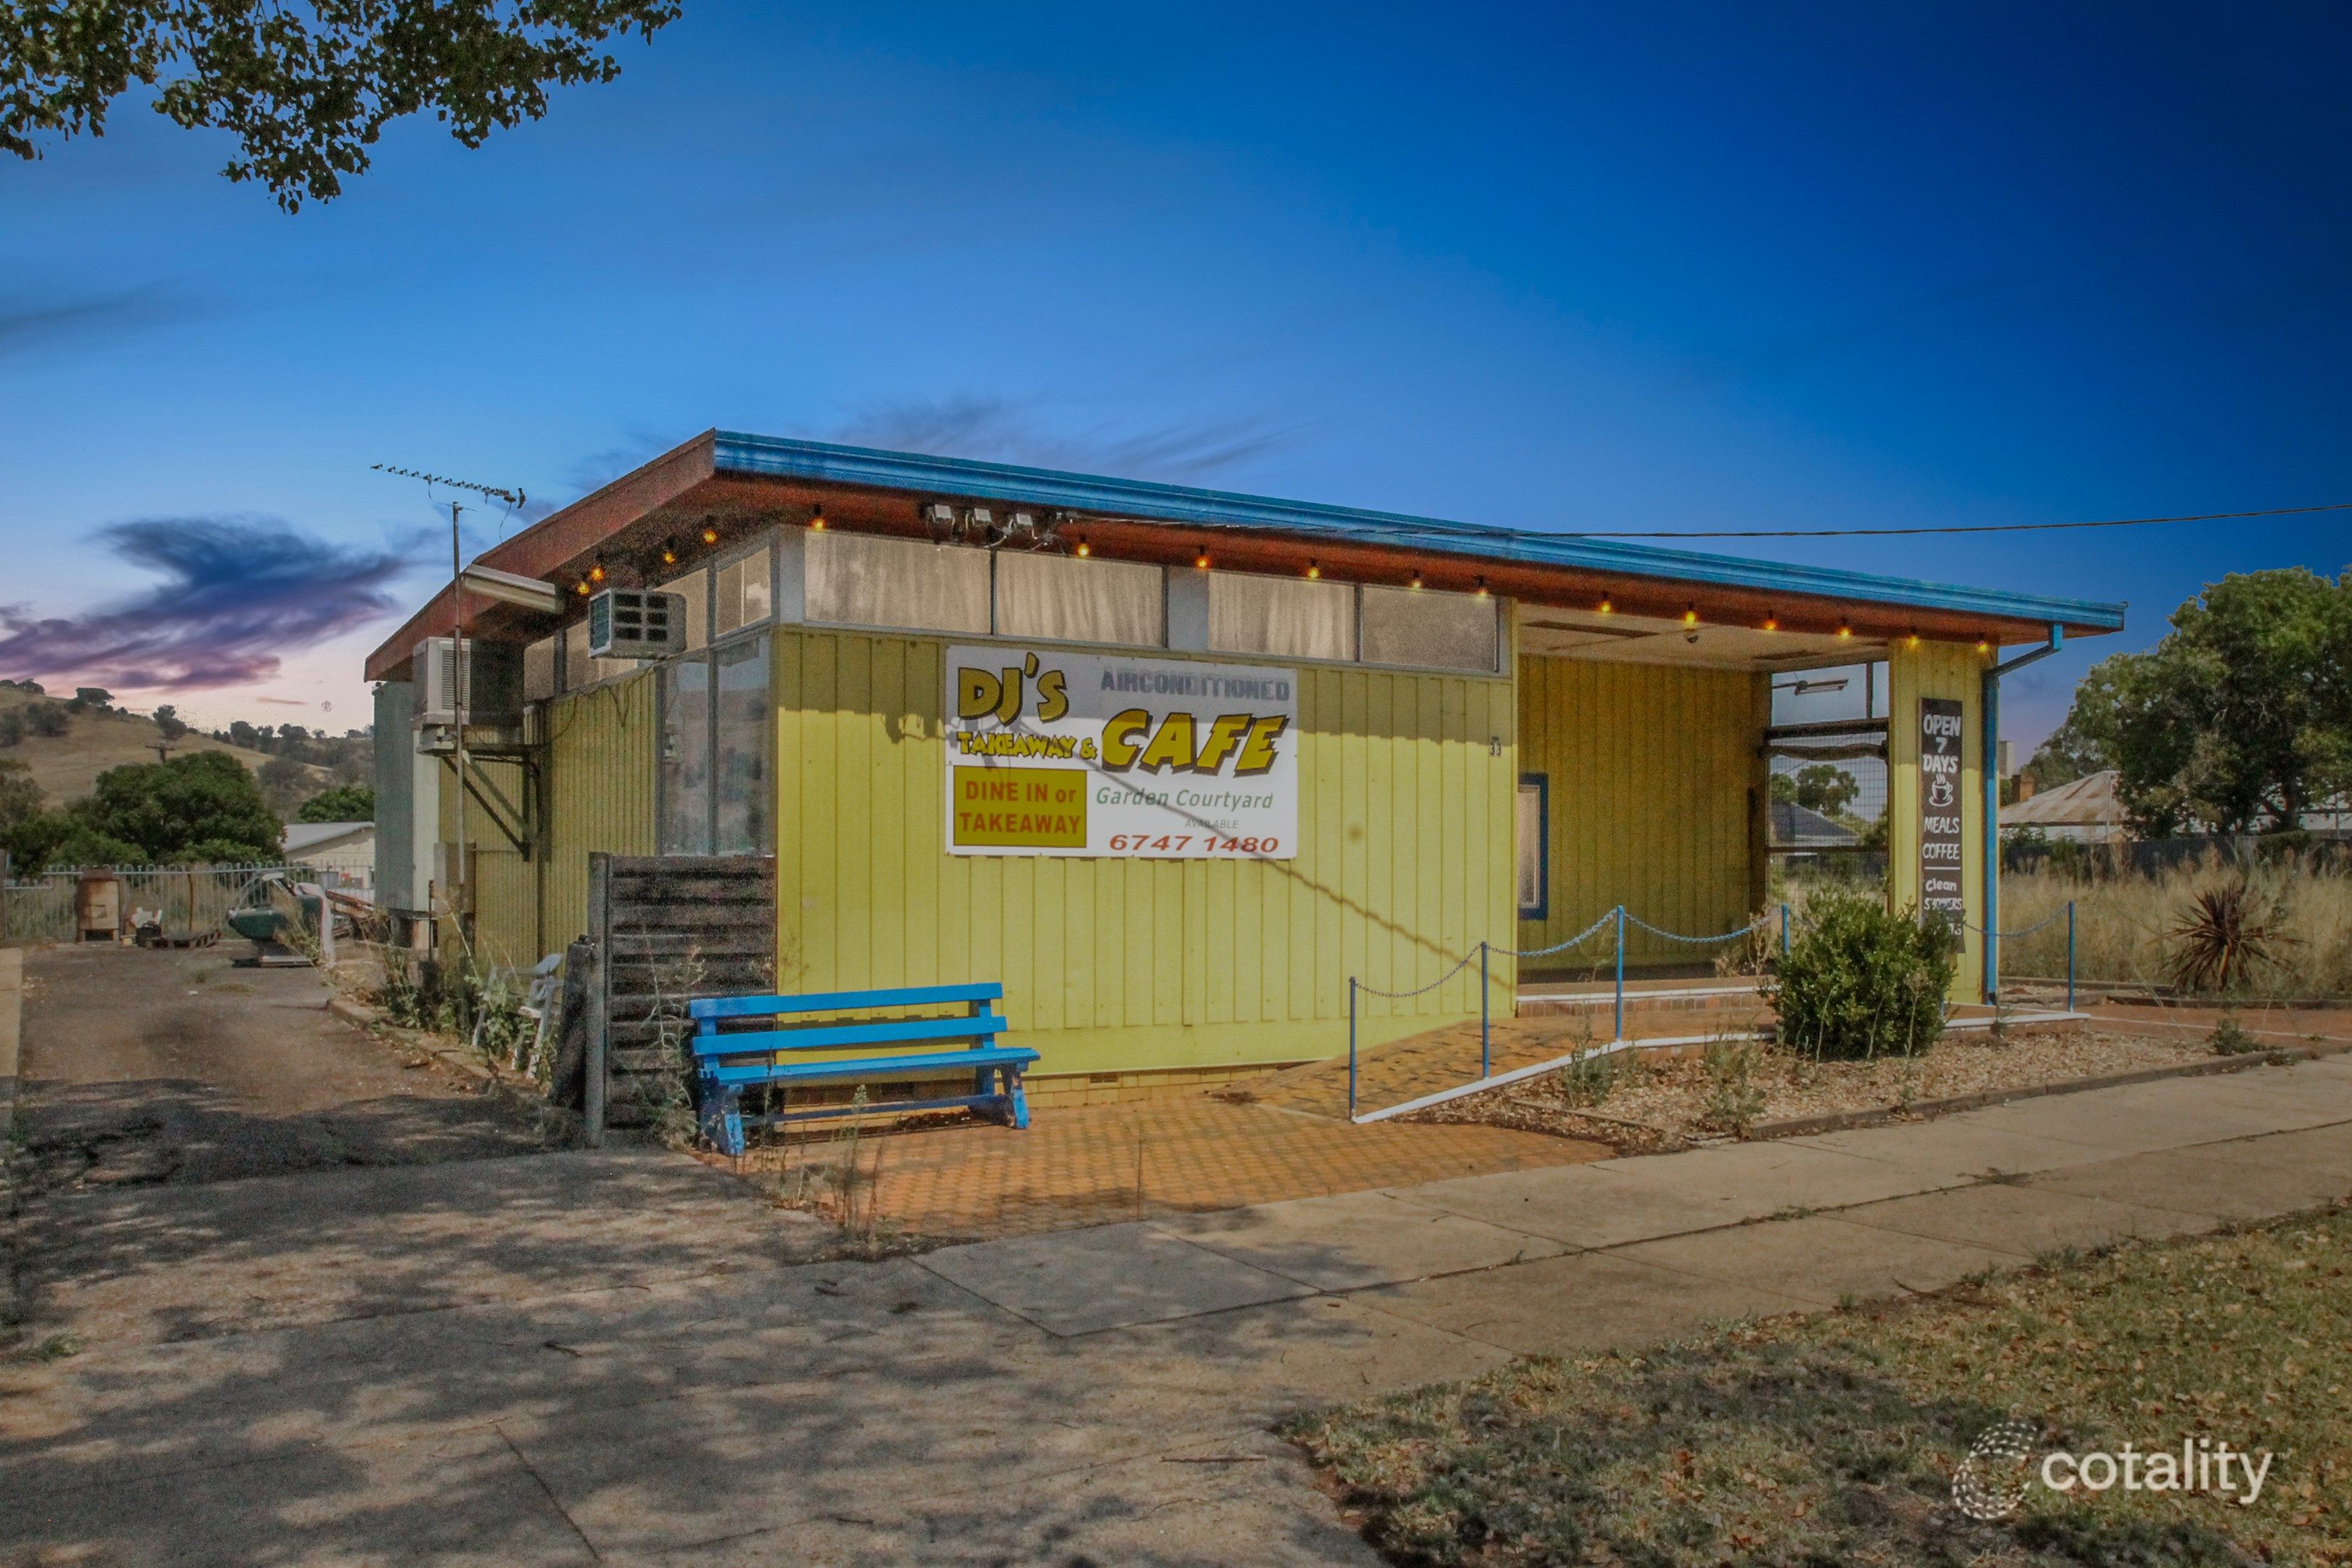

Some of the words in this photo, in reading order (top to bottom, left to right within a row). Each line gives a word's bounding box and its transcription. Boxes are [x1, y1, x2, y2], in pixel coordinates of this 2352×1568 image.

[957, 652, 1069, 726] DJ'S
[1101, 667, 1290, 702] AIRCONDITIONED
[1923, 714, 1961, 736] OPEN
[957, 731, 1077, 759] TAKEAWAY
[1079, 737, 1098, 760] &
[1101, 708, 1291, 777] CAFE
[1935, 736, 1948, 754] 7
[1922, 754, 1959, 774] DAYS
[965, 780, 1018, 801] DINE
[1026, 783, 1049, 802] IN
[1055, 788, 1076, 804] or
[1096, 786, 1169, 806] Garden
[1176, 788, 1274, 812] Courtyard
[959, 812, 1081, 834] TAKEAWAY
[1185, 818, 1239, 830] AVAILABLE
[1924, 816, 1960, 834] MEALS
[1108, 834, 1193, 852] 6747
[1203, 836, 1279, 853] 1480
[1922, 842, 1960, 860] COFFEE
[1925, 878, 1957, 892] Clean
